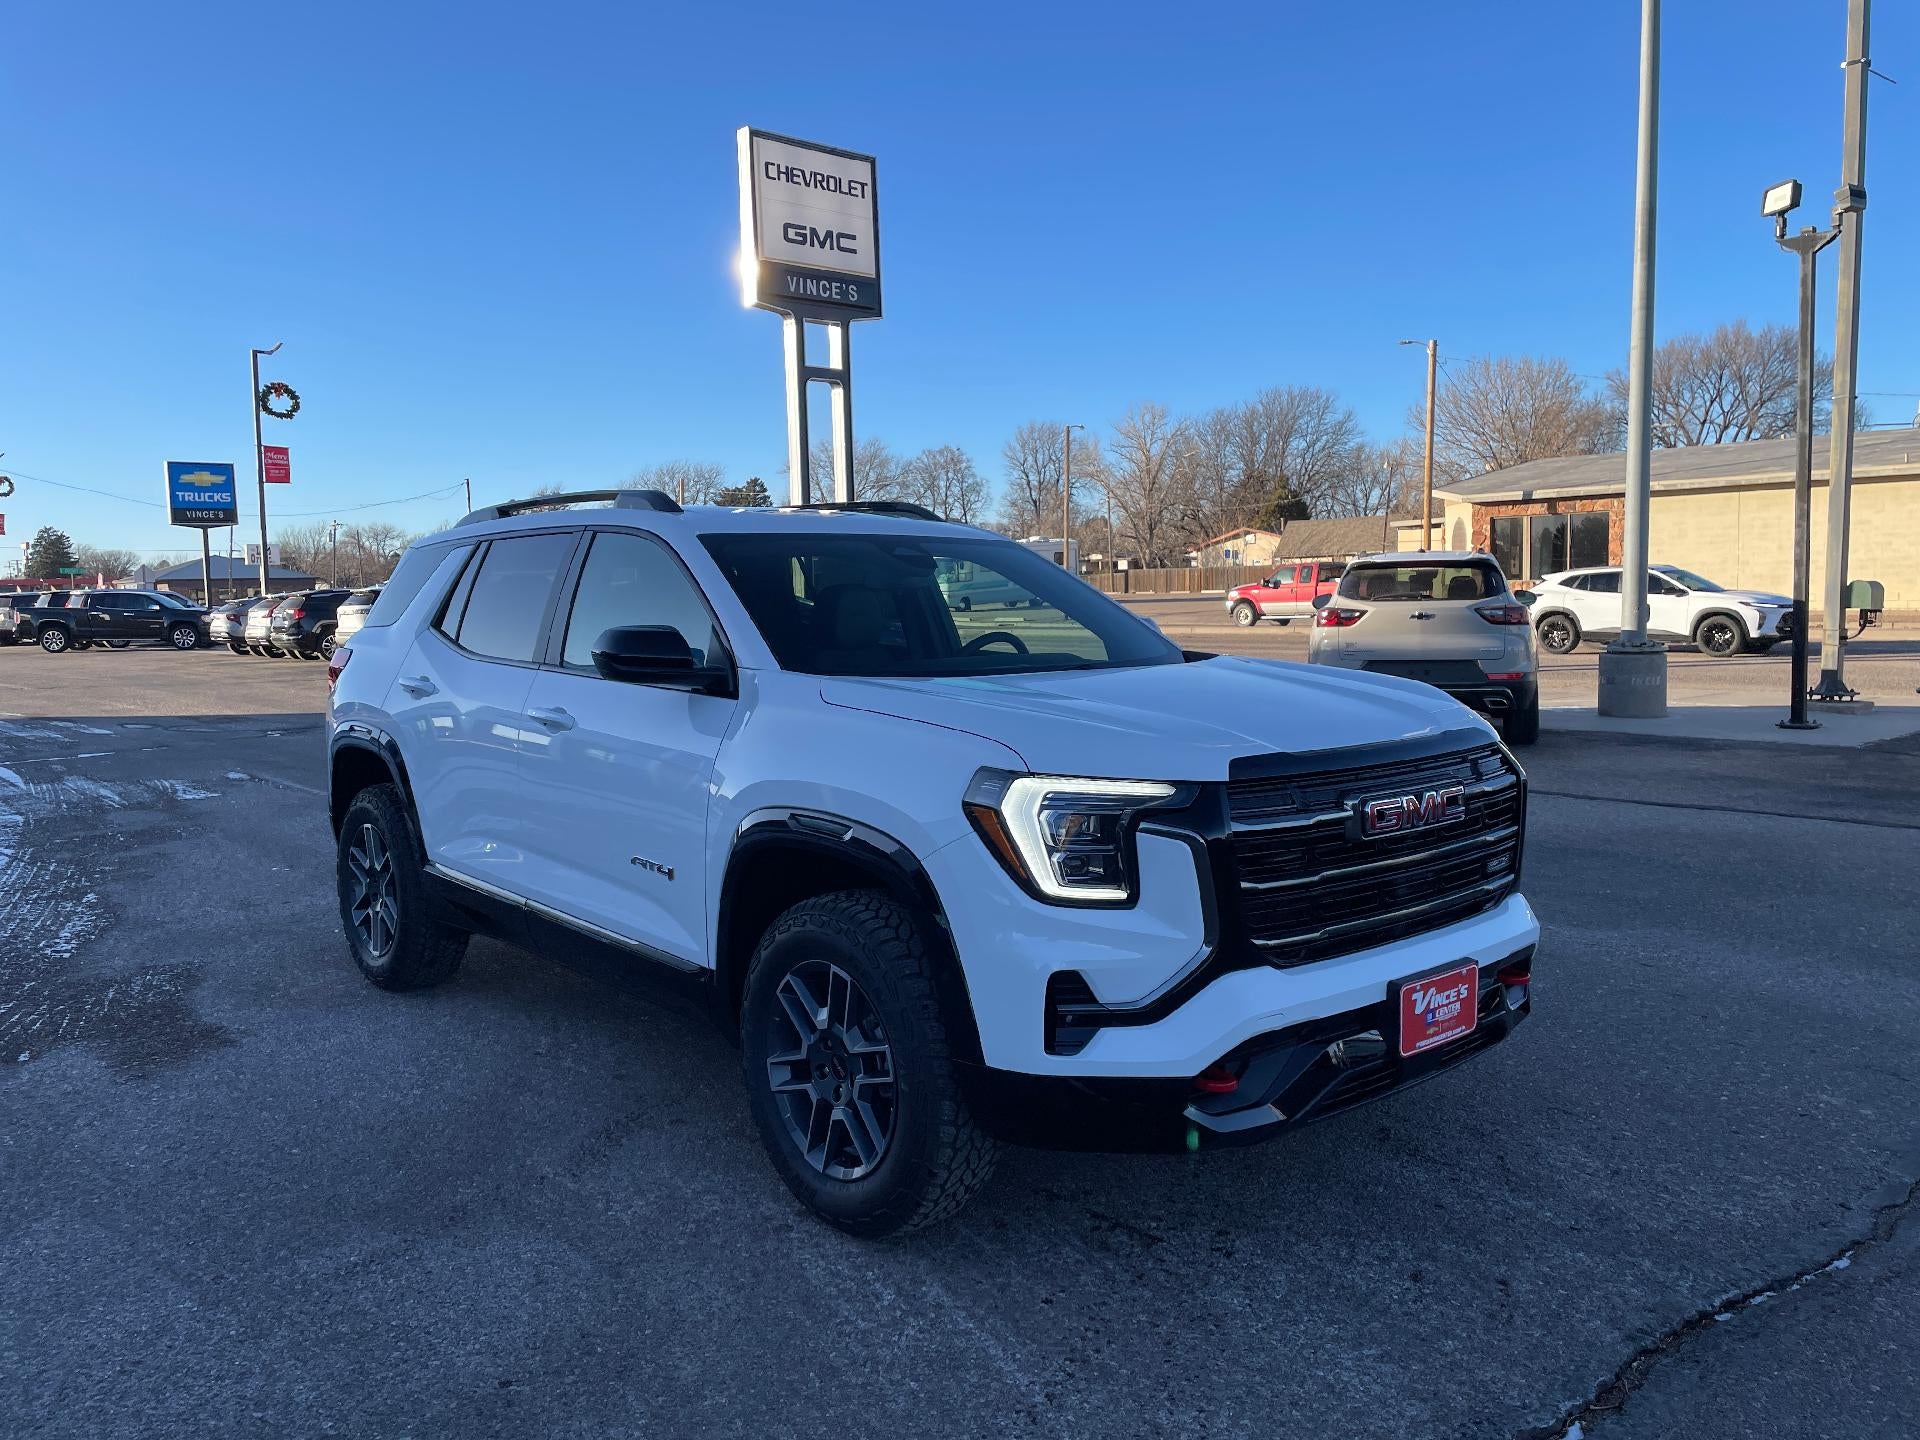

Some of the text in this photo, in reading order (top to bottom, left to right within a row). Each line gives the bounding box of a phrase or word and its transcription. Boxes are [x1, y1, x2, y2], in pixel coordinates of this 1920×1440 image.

[764, 161, 868, 199] CHEVROLET
[782, 222, 858, 255] GMC
[787, 275, 858, 302] VINCE'S
[176, 491, 231, 502] TRUCKS
[186, 510, 224, 519] VINCE'S
[1368, 786, 1465, 832] GMC
[630, 856, 674, 881] AT4
[1435, 1002, 1460, 1017] CENTER
